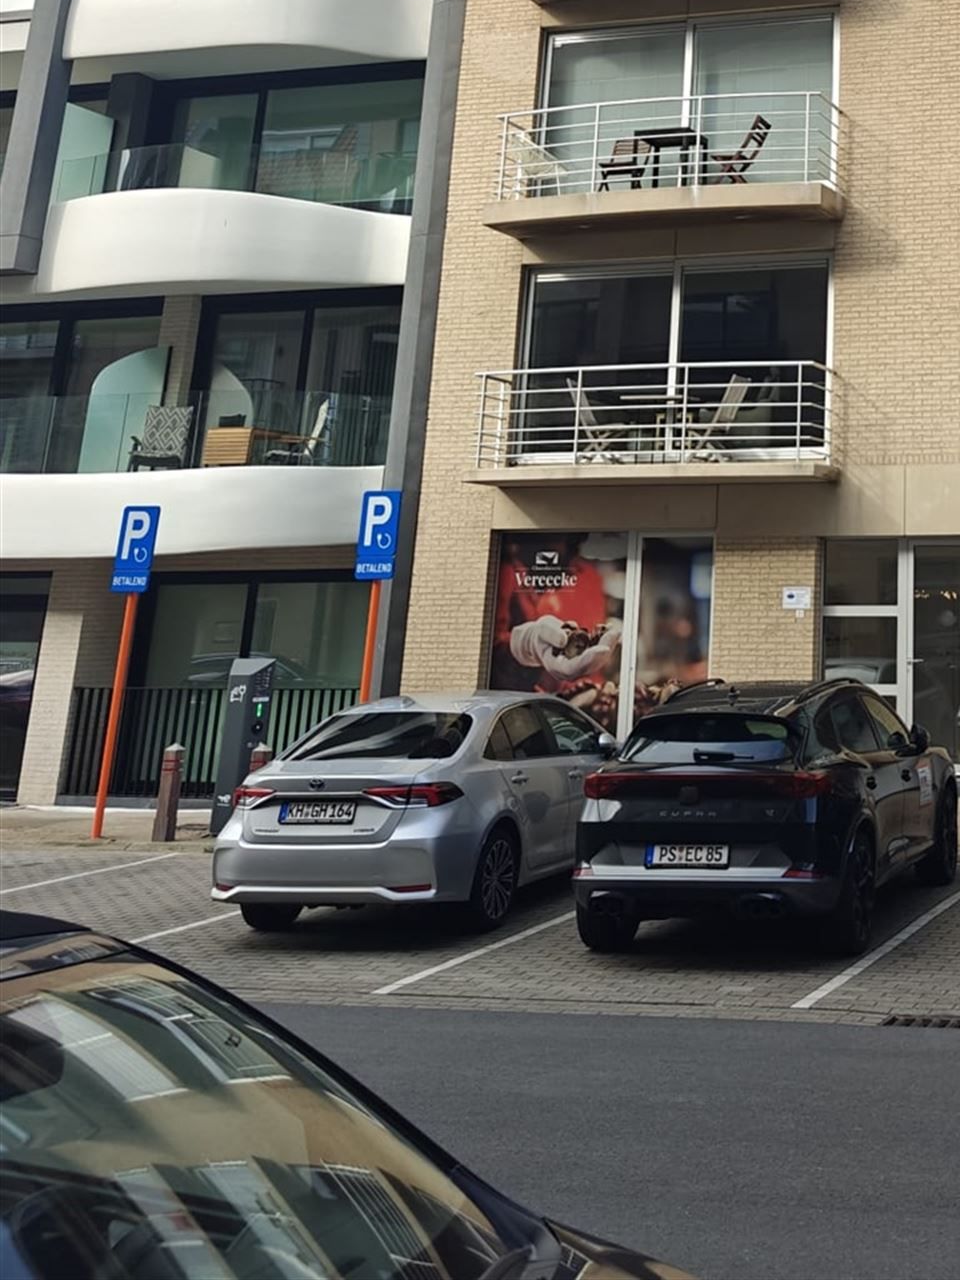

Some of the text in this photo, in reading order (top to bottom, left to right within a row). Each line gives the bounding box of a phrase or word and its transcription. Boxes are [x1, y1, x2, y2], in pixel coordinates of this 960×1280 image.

[121, 511, 151, 560] P
[363, 496, 392, 547] P
[112, 576, 147, 586] BETALEND
[356, 563, 392, 573] BETALEND
